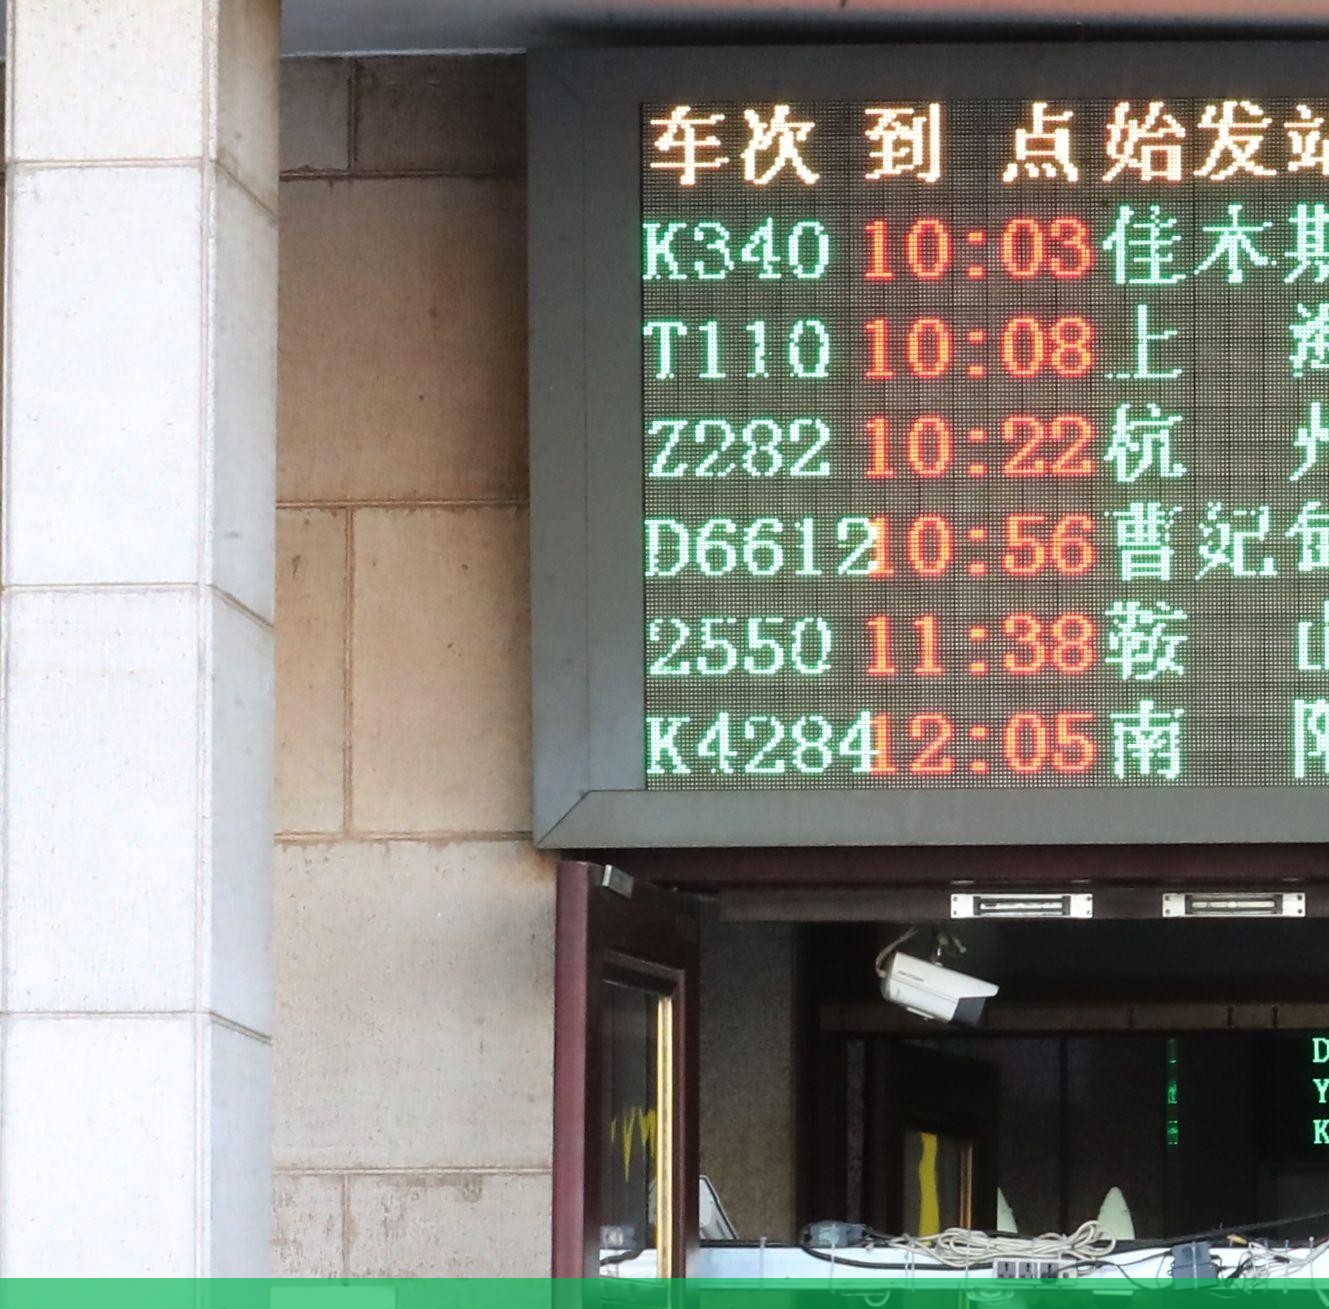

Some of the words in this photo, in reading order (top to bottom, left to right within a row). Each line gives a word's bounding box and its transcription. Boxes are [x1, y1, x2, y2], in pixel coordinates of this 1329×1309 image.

[651, 104, 821, 186] 车次
[641, 217, 831, 282] K340
[864, 216, 1097, 281] 10:03
[642, 318, 832, 382] T110
[864, 315, 1097, 382] 10:08
[645, 416, 832, 481] Z282
[864, 414, 1099, 481] 10:22
[643, 515, 877, 580] D6612
[866, 513, 1099, 580] 10:56
[647, 614, 834, 679] 2550
[865, 612, 1099, 679] 11:38
[644, 710, 880, 778] K4284
[869, 711, 1099, 777] 12:05
